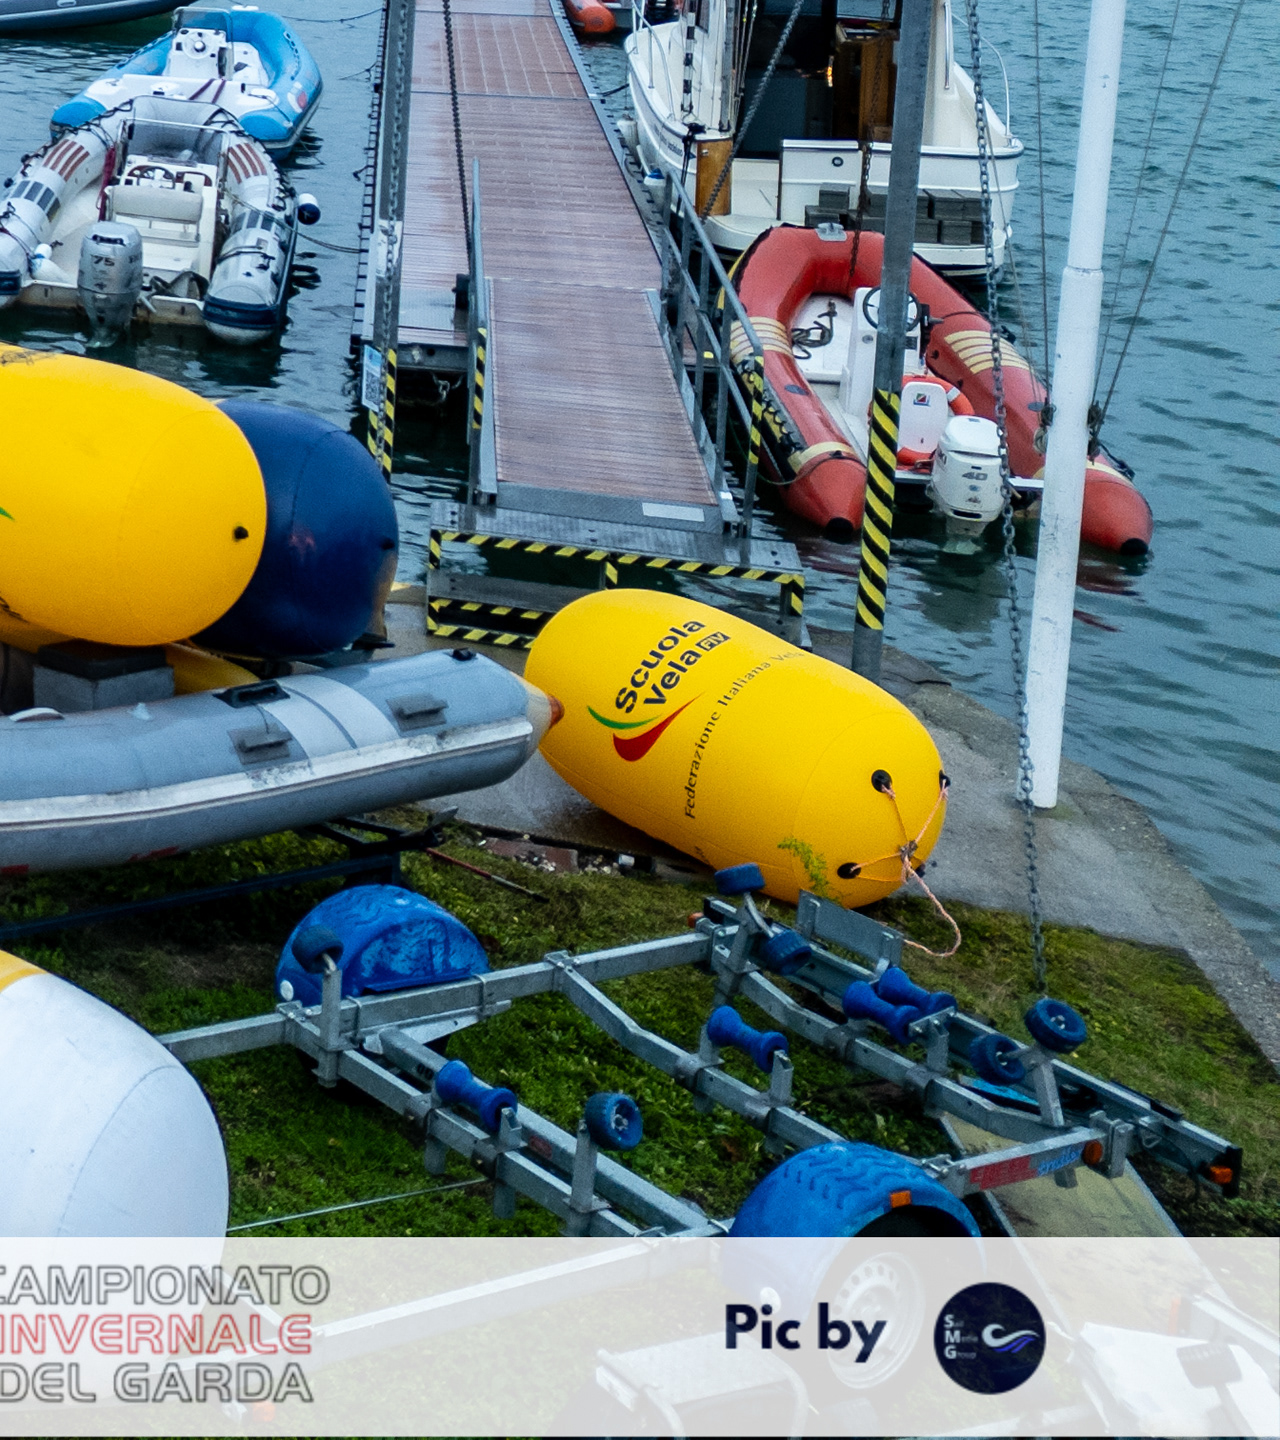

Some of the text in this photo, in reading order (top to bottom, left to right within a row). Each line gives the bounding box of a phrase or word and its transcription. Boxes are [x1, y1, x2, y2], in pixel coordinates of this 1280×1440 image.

[615, 620, 706, 714] Scuola
[643, 632, 729, 705] Vela FIV
[684, 712, 721, 820] Federazione
[718, 661, 771, 707] Italiana
